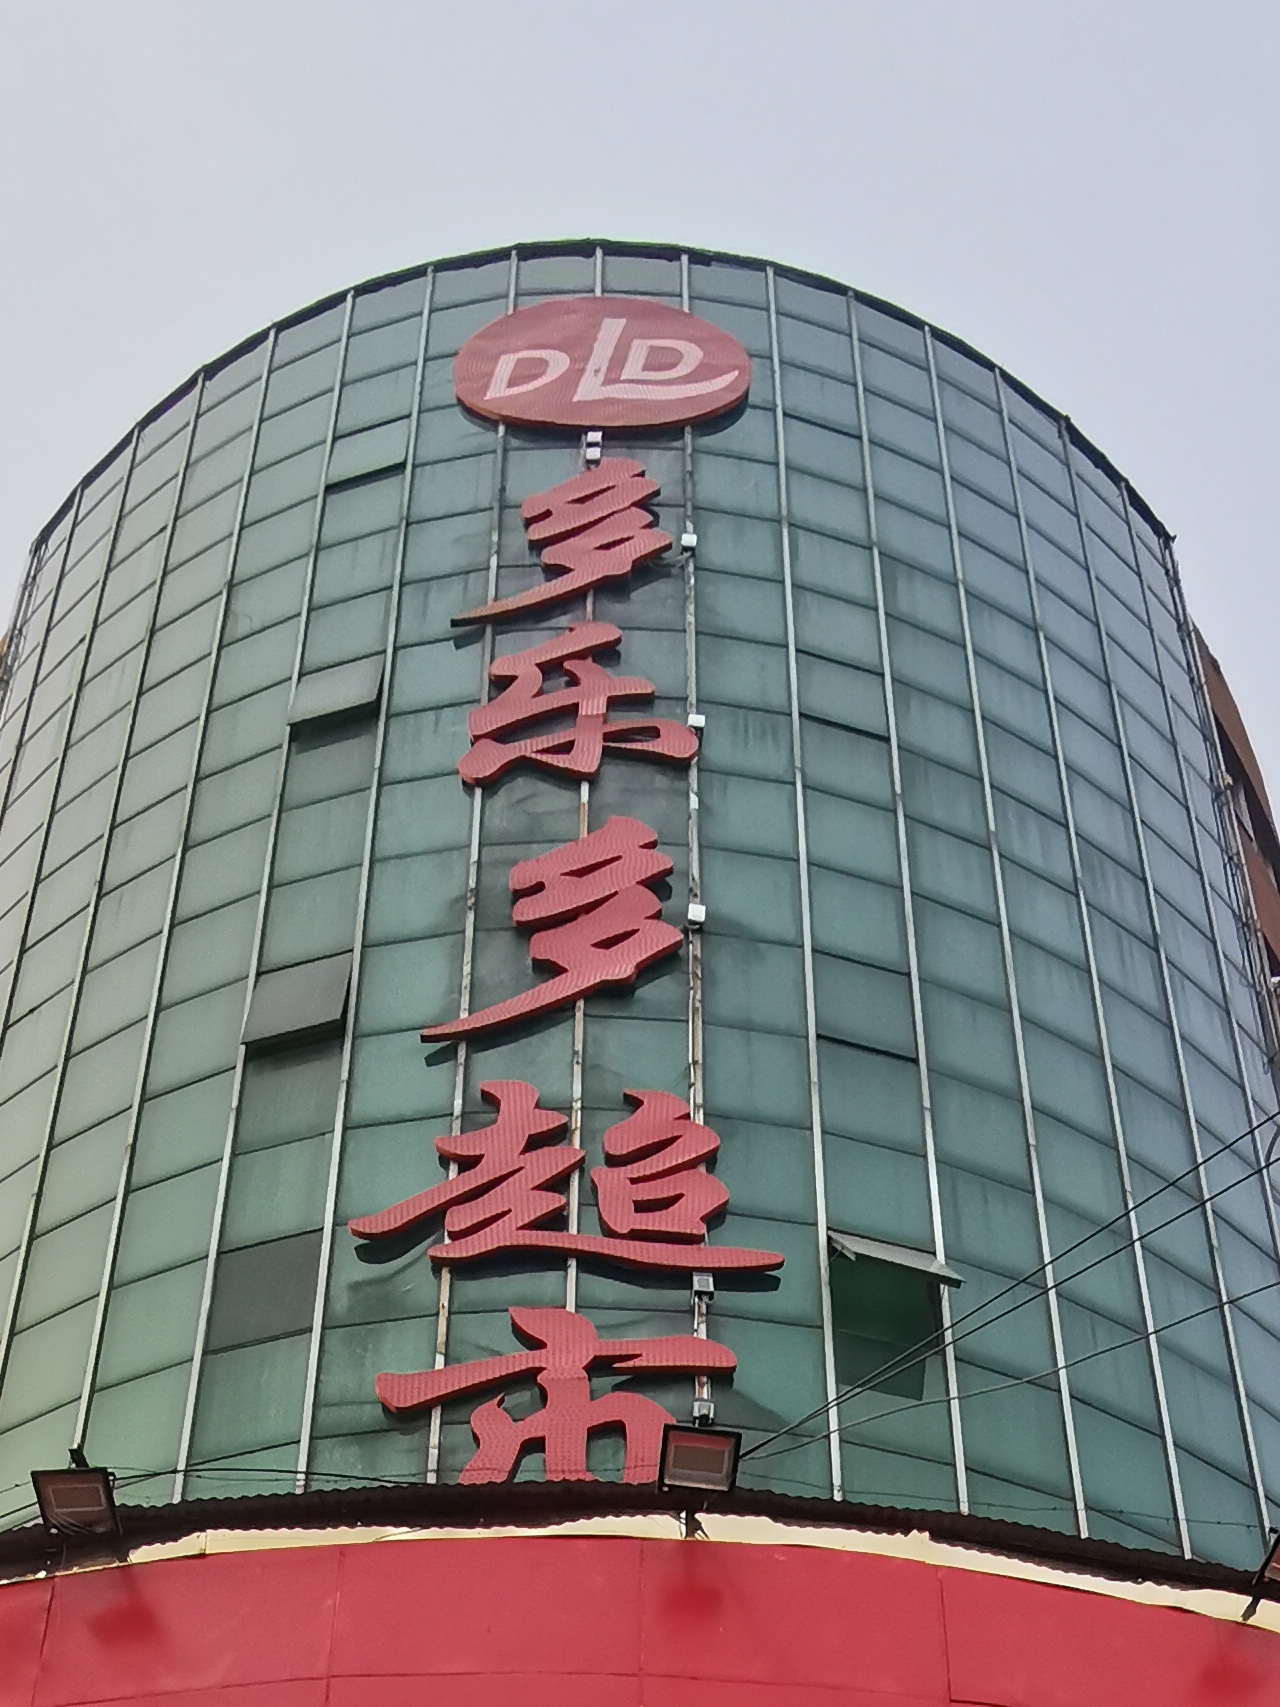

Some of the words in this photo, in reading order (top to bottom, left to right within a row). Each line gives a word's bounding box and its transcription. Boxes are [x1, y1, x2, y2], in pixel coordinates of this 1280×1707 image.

[485, 317, 739, 402] DLD
[348, 457, 785, 1486] 多乐多超市
